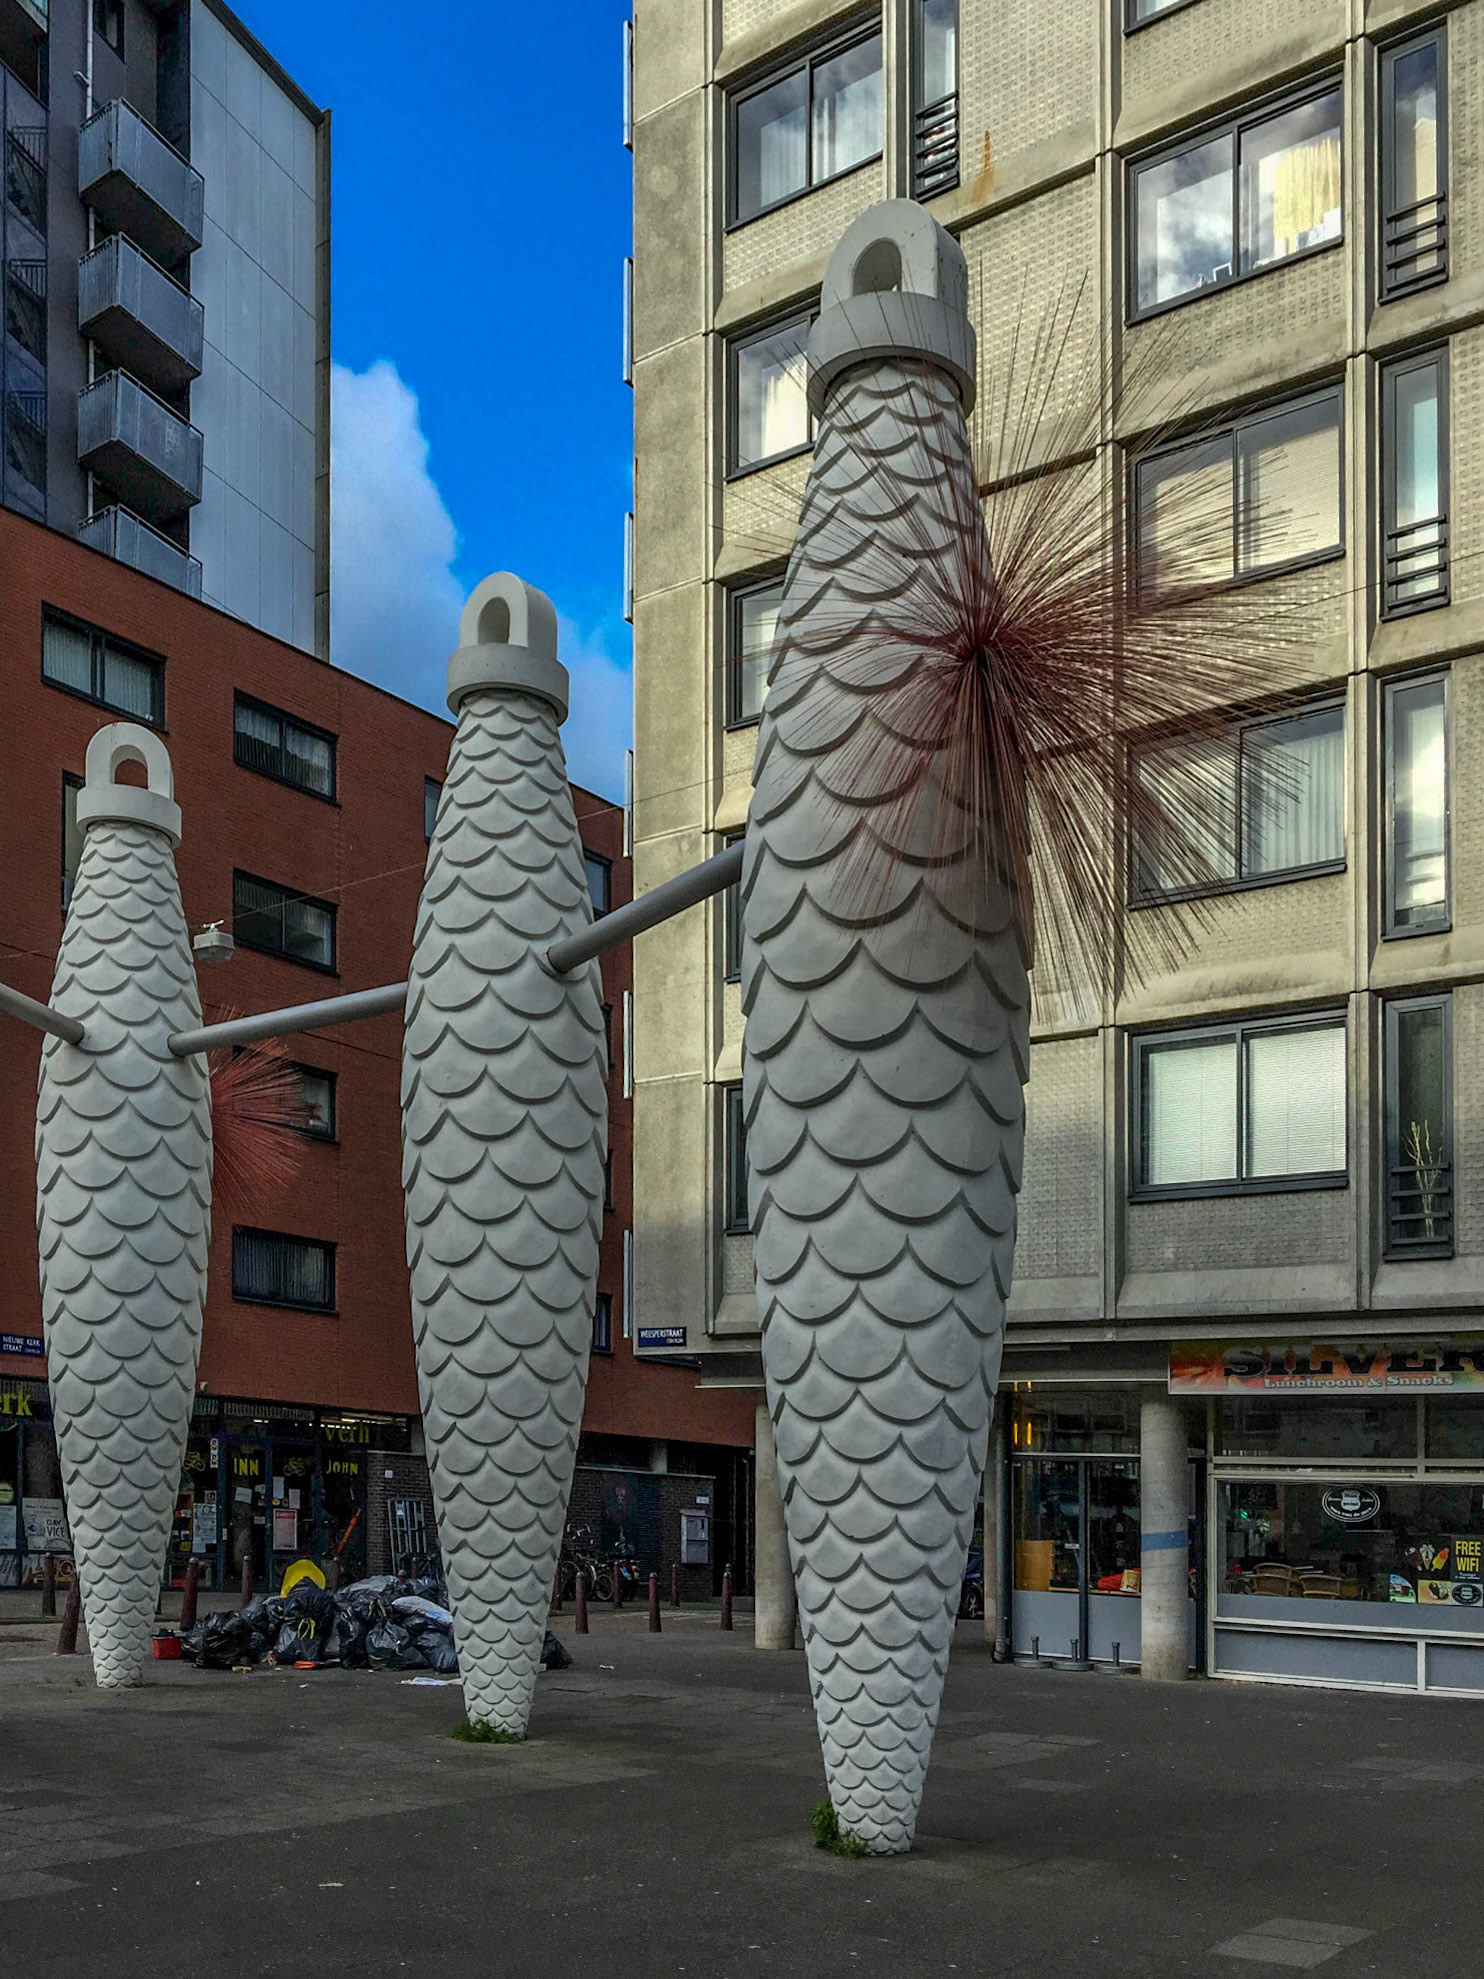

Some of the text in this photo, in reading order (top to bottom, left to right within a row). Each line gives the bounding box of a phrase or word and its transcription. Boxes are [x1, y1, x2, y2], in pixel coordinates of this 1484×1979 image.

[640, 1328, 684, 1338] WEESPERSTRAAT
[2, 1335, 41, 1348] NIEUWE KERK
[2, 1344, 22, 1352] STRAAT
[1264, 1375, 1454, 1389] Lunchroom & Snacks
[0, 1384, 33, 1416] rk
[233, 1456, 359, 1477] INN JOHN
[1455, 1540, 1482, 1556] FREE
[1456, 1557, 1480, 1572] WIFI
